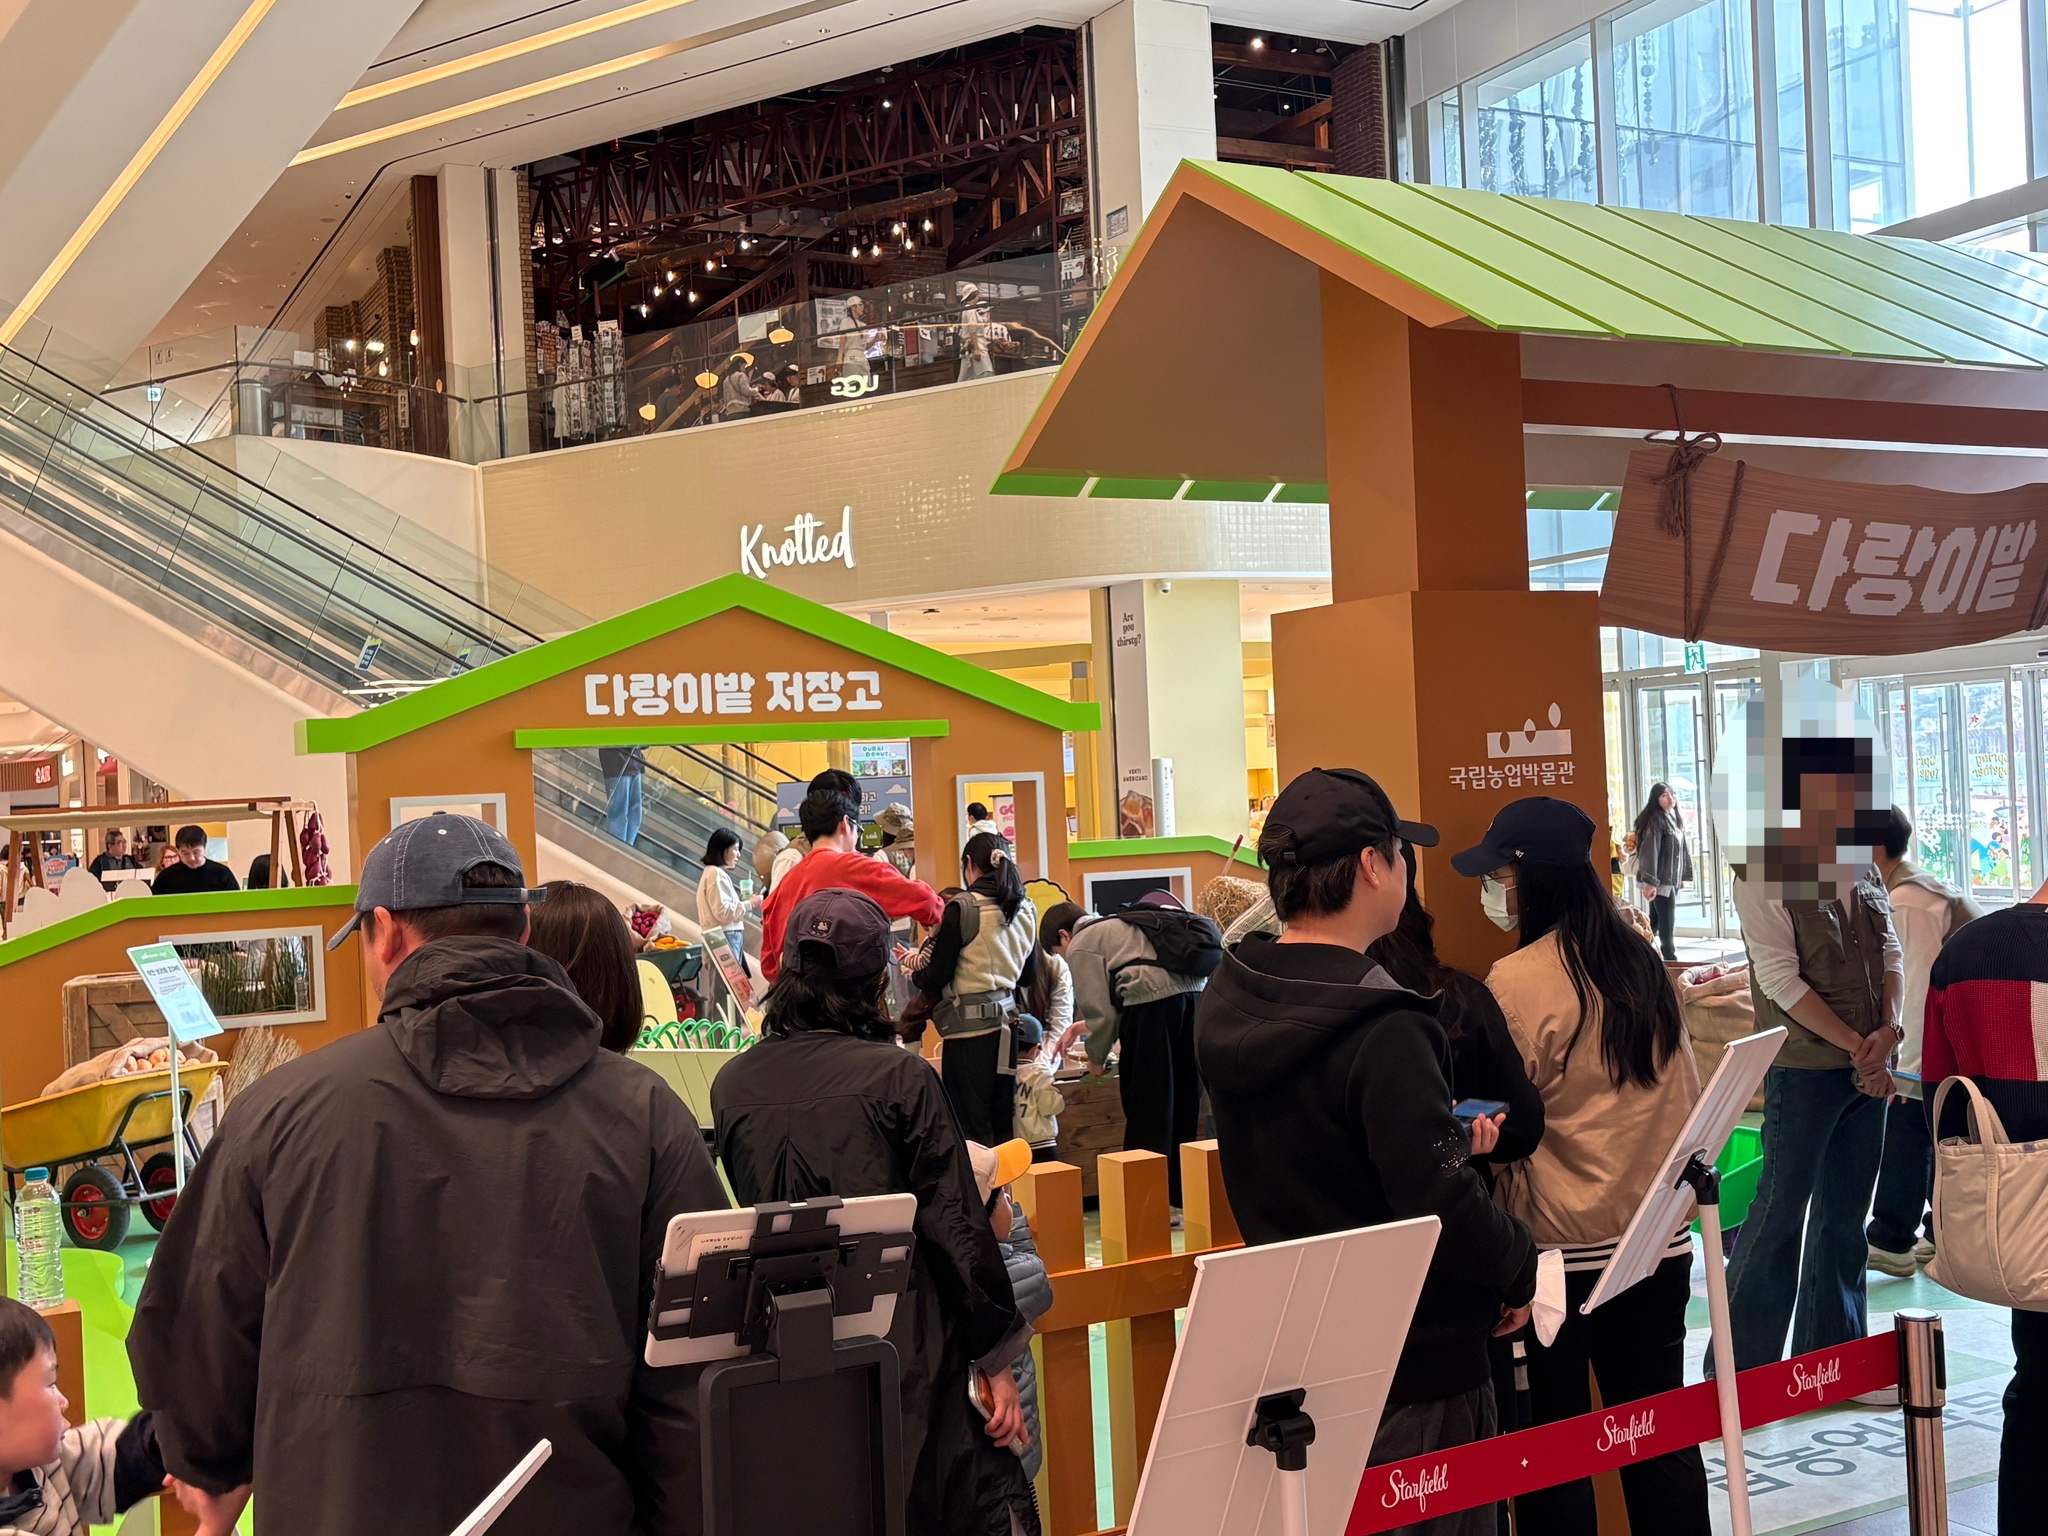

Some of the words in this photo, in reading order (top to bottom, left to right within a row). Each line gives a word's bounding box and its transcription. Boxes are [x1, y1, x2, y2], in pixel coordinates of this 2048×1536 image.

[740, 505, 855, 579] Knotted
[1750, 508, 2037, 616] 다랑이밭
[1122, 612, 1134, 623] Are
[1123, 624, 1135, 634] you
[1116, 633, 1142, 647] thirsty?
[584, 671, 755, 717] 다랑이밭
[766, 670, 883, 713] 저장고
[1448, 760, 1576, 792] 국립농업박물관
[999, 804, 1014, 816] GO
[1787, 1358, 1842, 1401] Starfield
[1596, 1409, 1656, 1456] Starfield
[1381, 1463, 1449, 1513] Starfield
